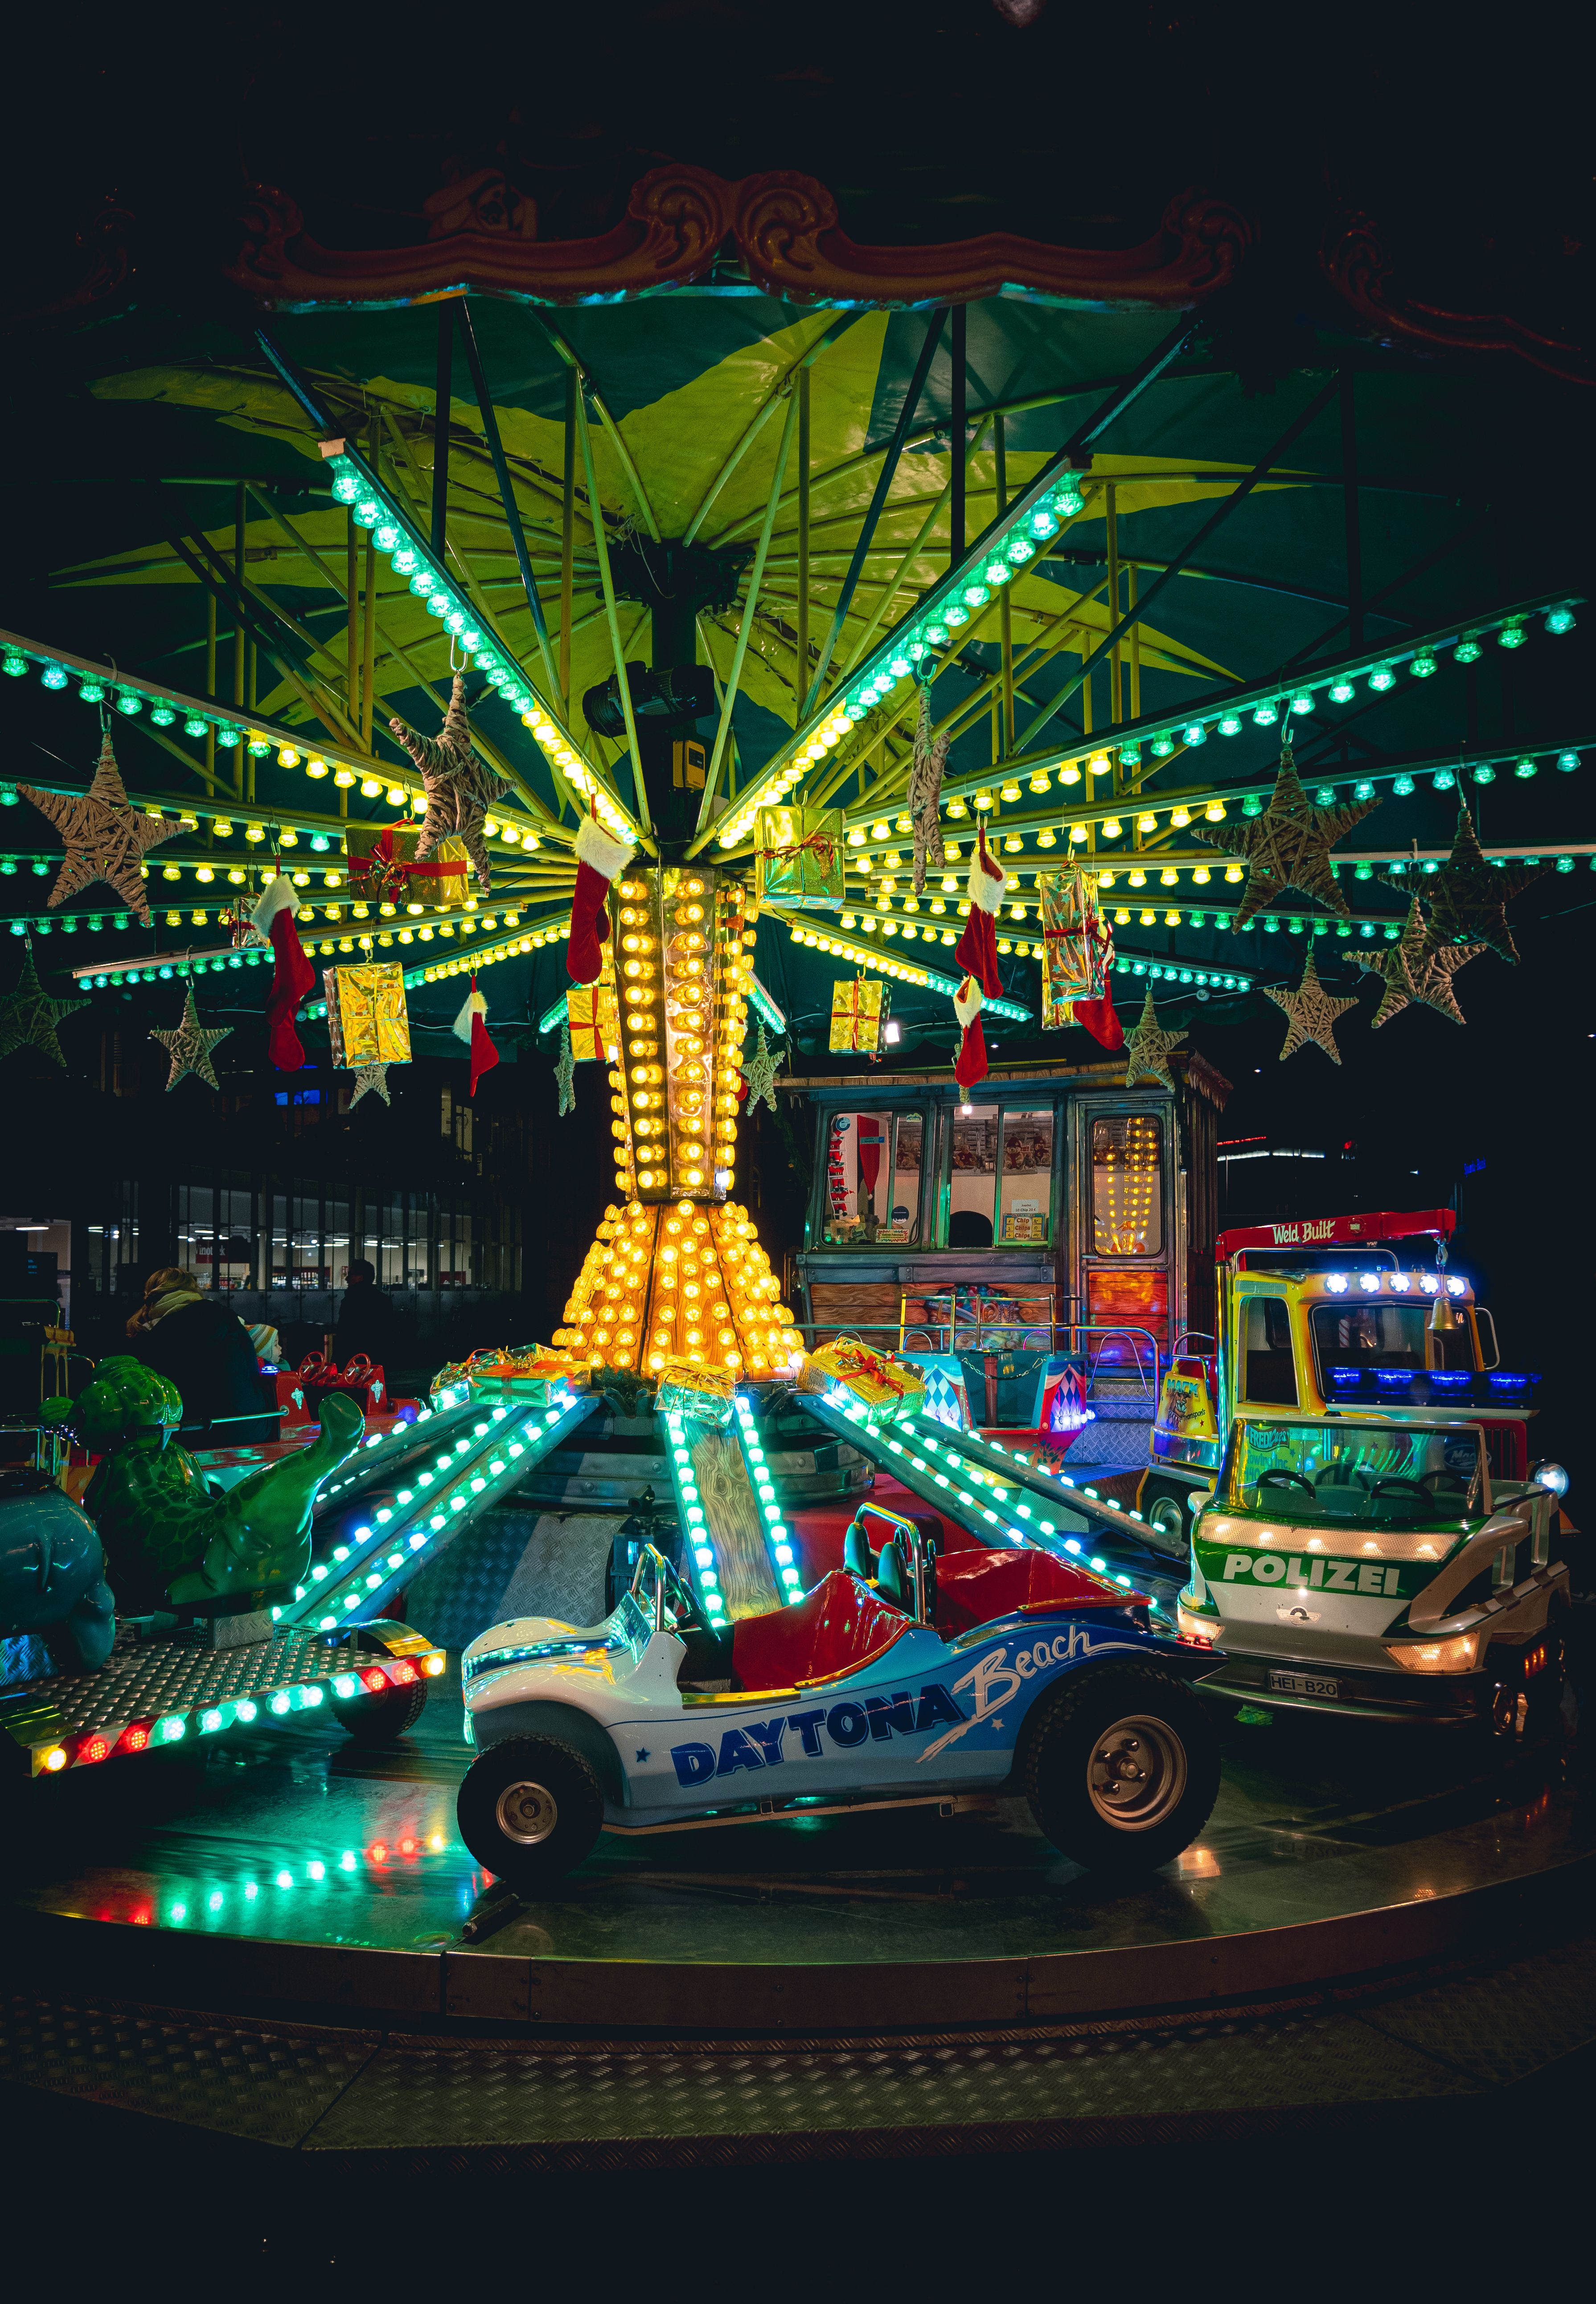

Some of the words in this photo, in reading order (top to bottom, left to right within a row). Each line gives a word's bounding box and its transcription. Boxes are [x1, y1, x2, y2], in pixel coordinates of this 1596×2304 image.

[1272, 1224, 1299, 1244] Weld
[1301, 1220, 1336, 1243] Built
[1166, 1378, 1199, 1398] MACK
[1223, 1554, 1400, 1595] POLIZEI
[1271, 1676, 1337, 1696] HEI-B20
[669, 1683, 969, 1787] DAYTONA
